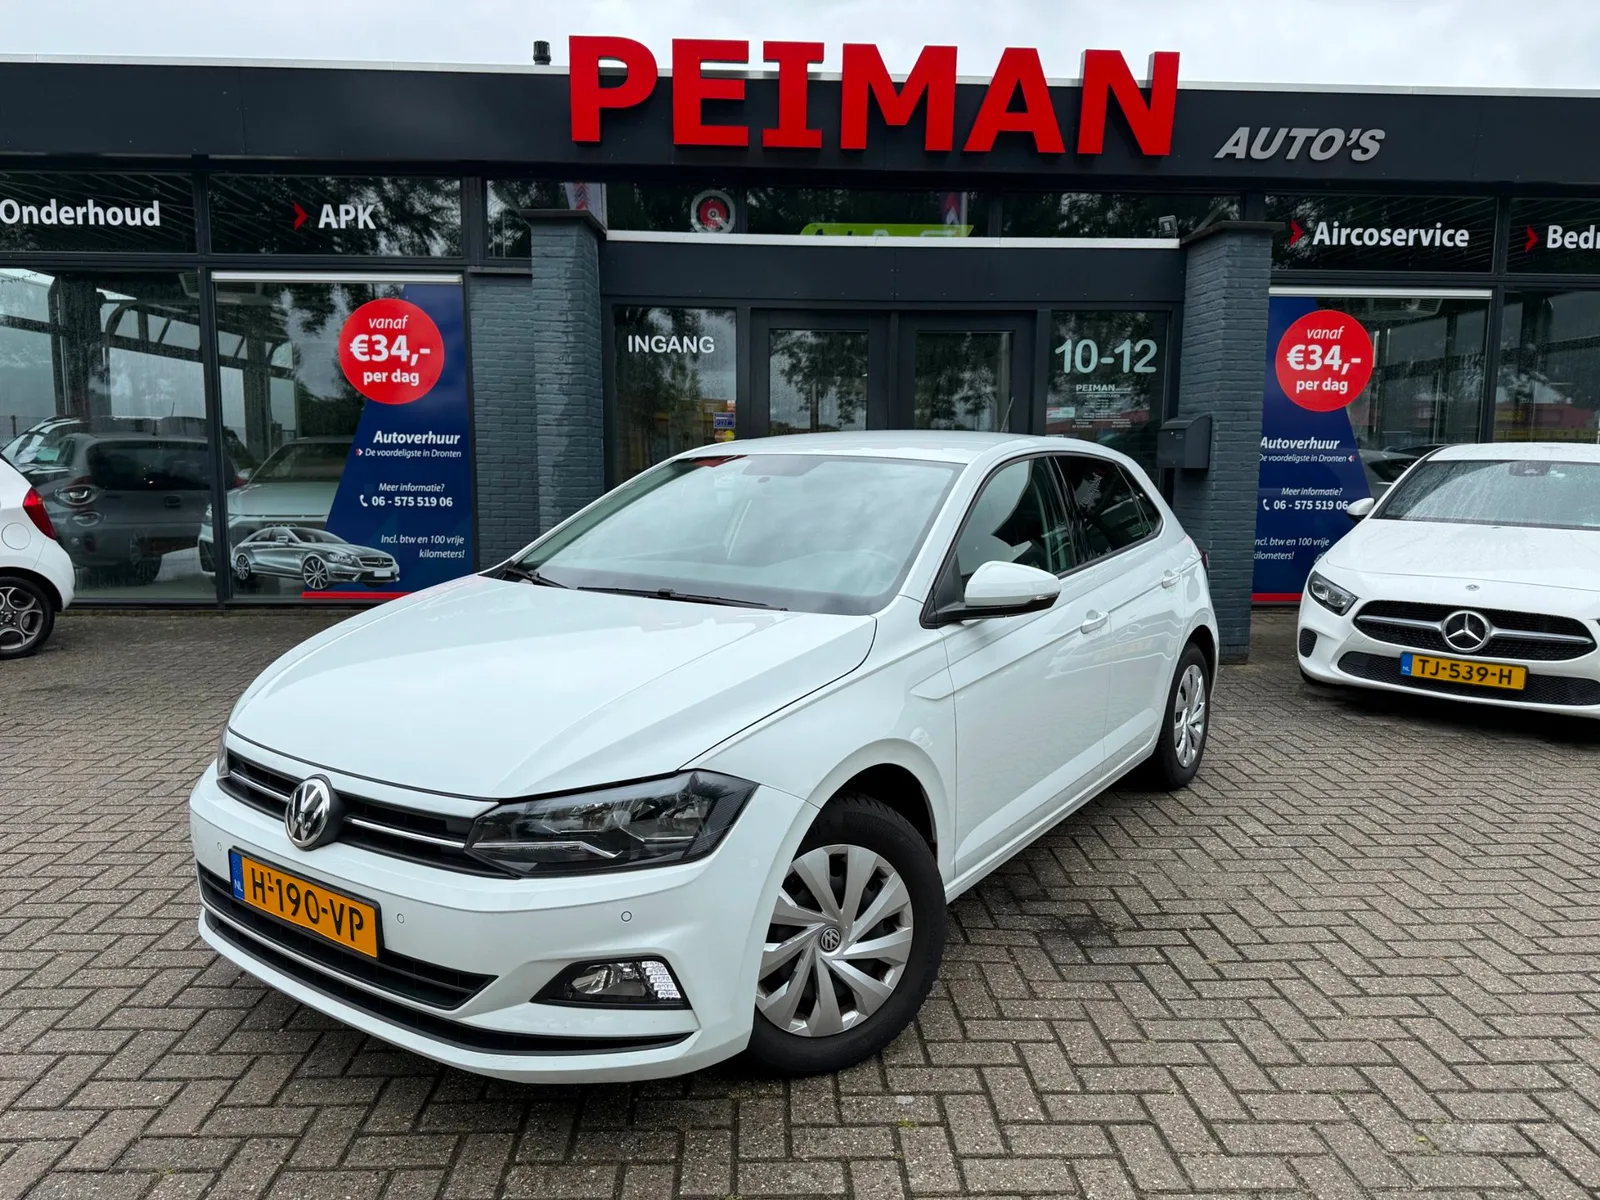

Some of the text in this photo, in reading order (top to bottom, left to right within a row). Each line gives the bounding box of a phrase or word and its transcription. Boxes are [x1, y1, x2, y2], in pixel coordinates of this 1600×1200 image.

[569, 35, 1386, 162] PEIMAN AUTO'S
[0, 198, 161, 226] Onderhoud
[318, 203, 376, 230] APK
[1312, 221, 1470, 247] Aircoservice
[368, 314, 409, 329] vanaf
[1306, 325, 1345, 340] vanaf
[349, 333, 431, 367] €34,-
[627, 335, 715, 354] INGANG
[1054, 338, 1158, 374] 10-12
[1286, 343, 1361, 375] €34,-
[363, 368, 419, 387] per dag
[1075, 383, 1116, 392] PEIMAN
[1296, 377, 1348, 394] per dag
[373, 430, 461, 445] Autoverhuur
[1260, 436, 1340, 450] Autoverhuur
[365, 447, 462, 459] De voordeligste in Dronten
[1268, 453, 1310, 464] voordeligste
[1311, 454, 1318, 462] in
[1318, 454, 1347, 463] Dronten
[378, 482, 445, 492] Meer informatie?
[1281, 487, 1343, 496] Meer informatie?
[371, 496, 386, 507] 06
[394, 496, 415, 507] 575
[416, 496, 437, 507] 519
[439, 496, 453, 507] 06
[1273, 500, 1286, 510] 06
[1294, 500, 1313, 510] 575
[1315, 500, 1334, 510] 519
[1336, 500, 1348, 510] 06
[381, 534, 464, 546] Incl. btw en 100 vrije
[1254, 537, 1269, 546] ncl.
[1269, 537, 1286, 546] btw
[1298, 537, 1312, 546] 100
[1313, 538, 1330, 548] vrije
[419, 549, 465, 558] kilometers!
[1418, 658, 1513, 685] TJ-539-H
[233, 867, 364, 942] NL H-190-VP
